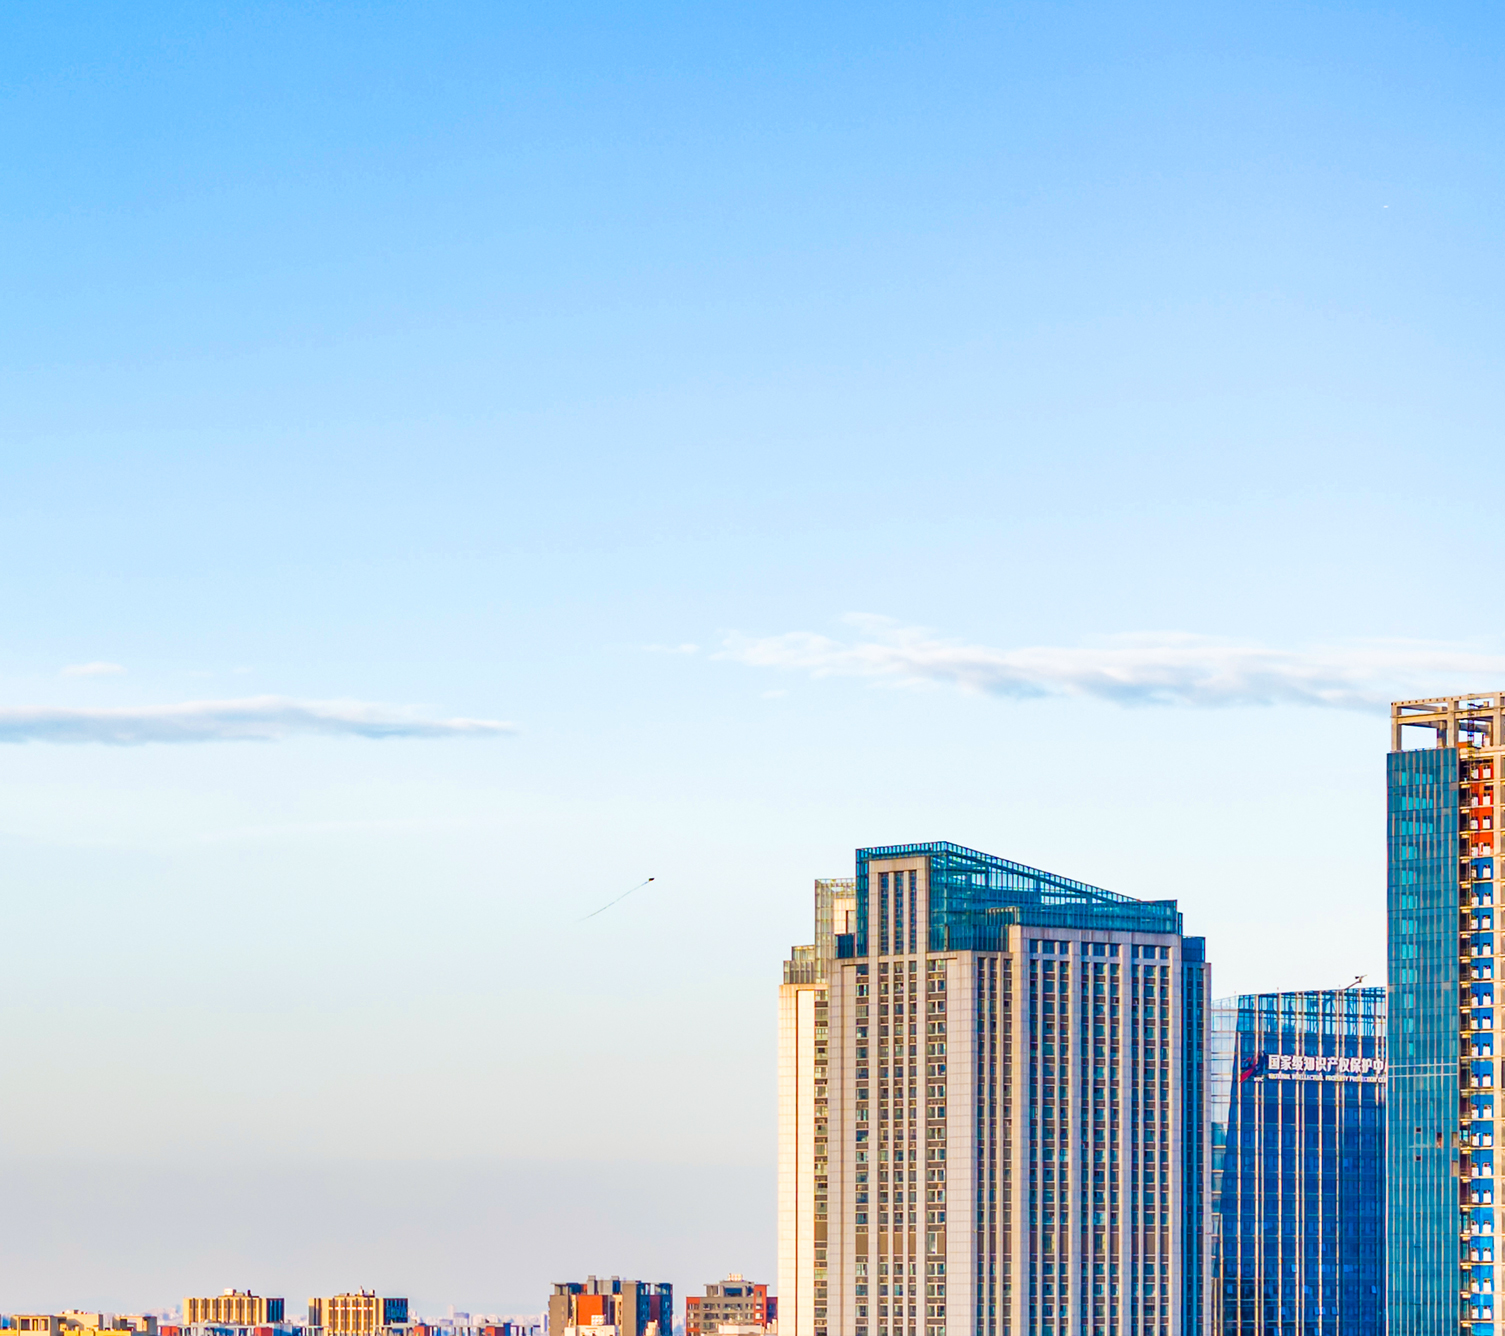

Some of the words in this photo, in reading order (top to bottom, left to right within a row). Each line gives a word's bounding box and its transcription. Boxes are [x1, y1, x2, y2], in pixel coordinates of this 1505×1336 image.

[1268, 1054, 1386, 1074] 国家级知识产权保护中
